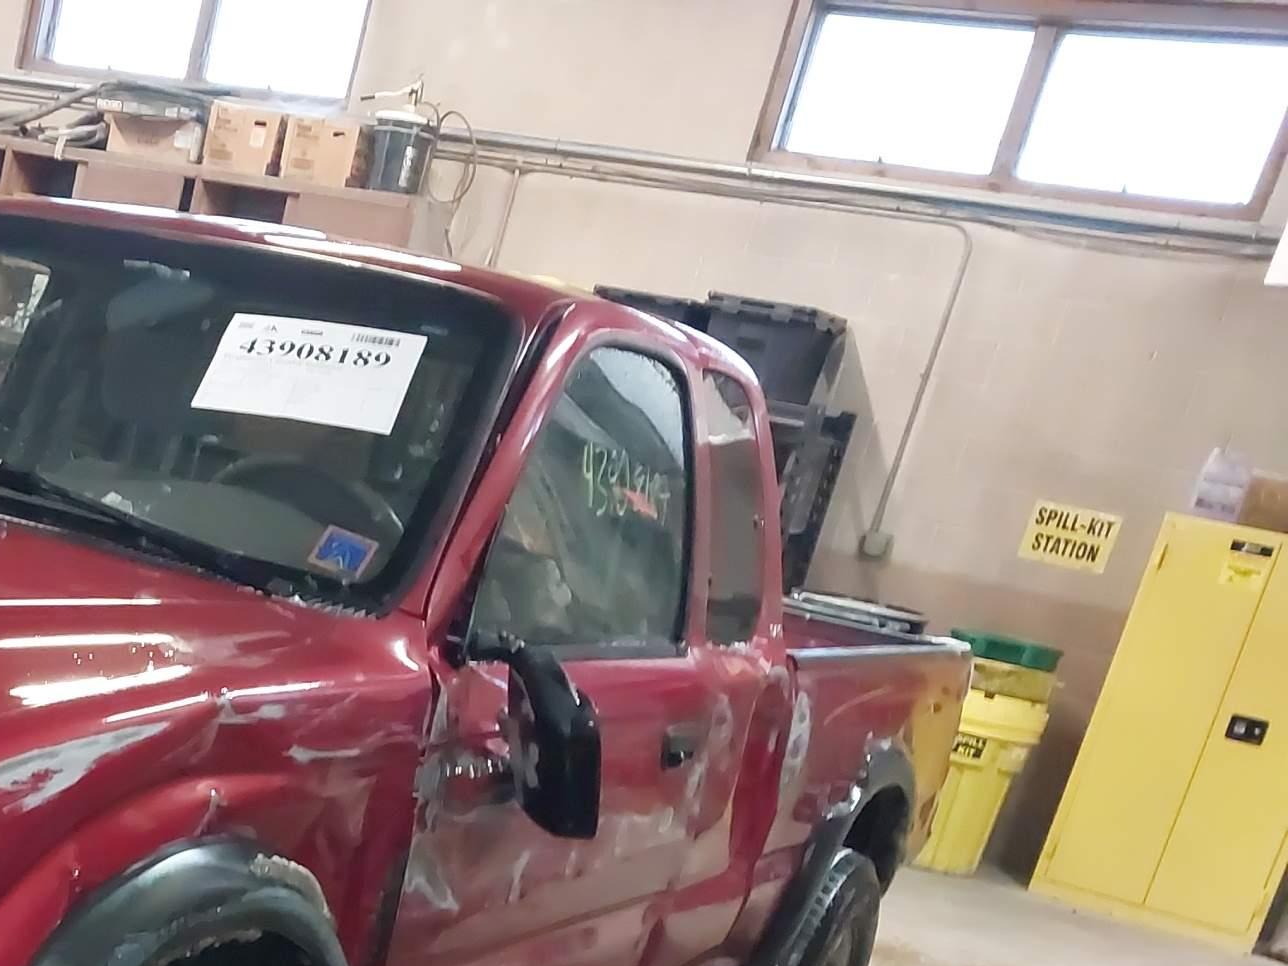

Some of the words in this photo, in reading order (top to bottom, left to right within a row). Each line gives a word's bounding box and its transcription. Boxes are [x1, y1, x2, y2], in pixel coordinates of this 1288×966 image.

[239, 337, 392, 368] 43908189
[1034, 506, 1115, 539] SPILL-KIT
[1031, 532, 1100, 563] STATION
